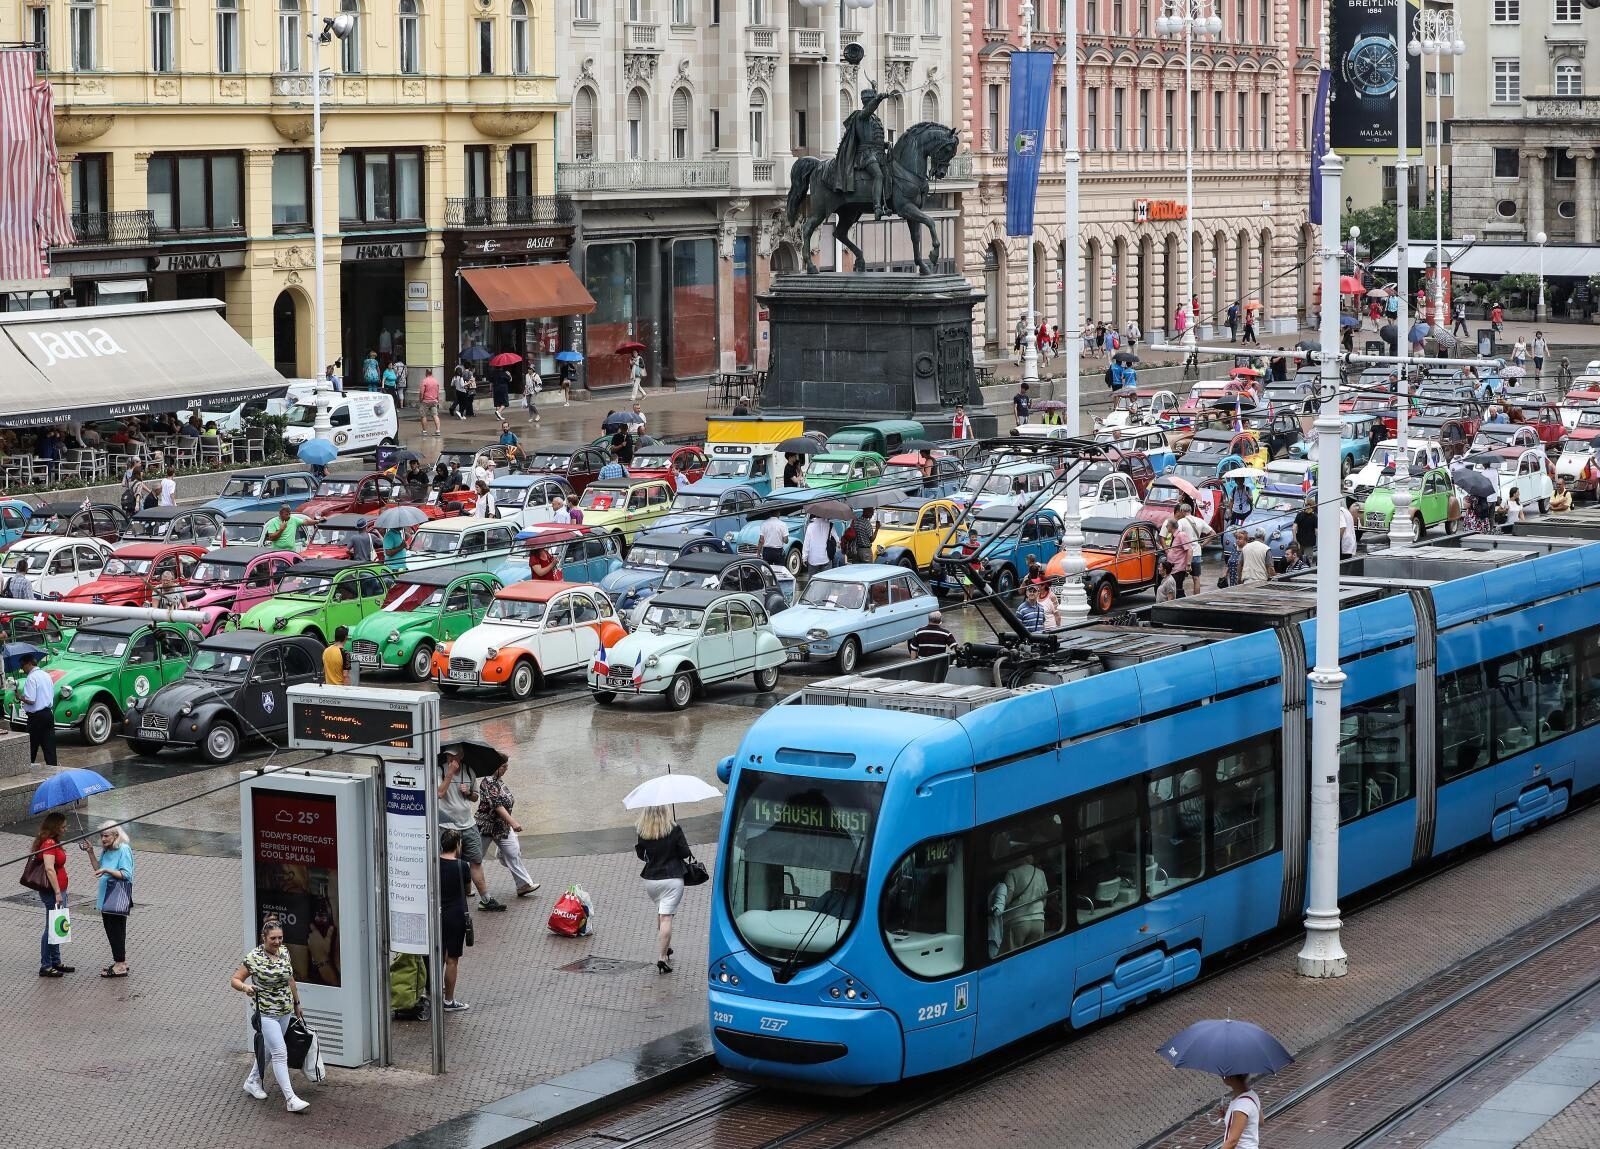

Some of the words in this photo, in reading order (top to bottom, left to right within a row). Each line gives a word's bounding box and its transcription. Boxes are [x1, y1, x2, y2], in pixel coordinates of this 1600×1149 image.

[1149, 200, 1187, 219] Müller
[526, 237, 555, 248] BASLER
[356, 245, 403, 259] HARMICA
[168, 254, 221, 270] HARMICA
[109, 406, 126, 415] MALA
[128, 403, 150, 413] KAVANA
[30, 416, 54, 426] MINERAL
[54, 414, 72, 422] WATER
[754, 801, 770, 821] 14
[260, 830, 292, 840] TODAY'S
[293, 834, 334, 845] FORECAST:
[261, 842, 290, 851] REFRESH
[291, 845, 308, 853] WITH
[261, 850, 283, 859] COOL
[285, 852, 315, 862] SPLASH
[714, 1011, 733, 1023] 2297
[918, 1002, 948, 1021] 2297
